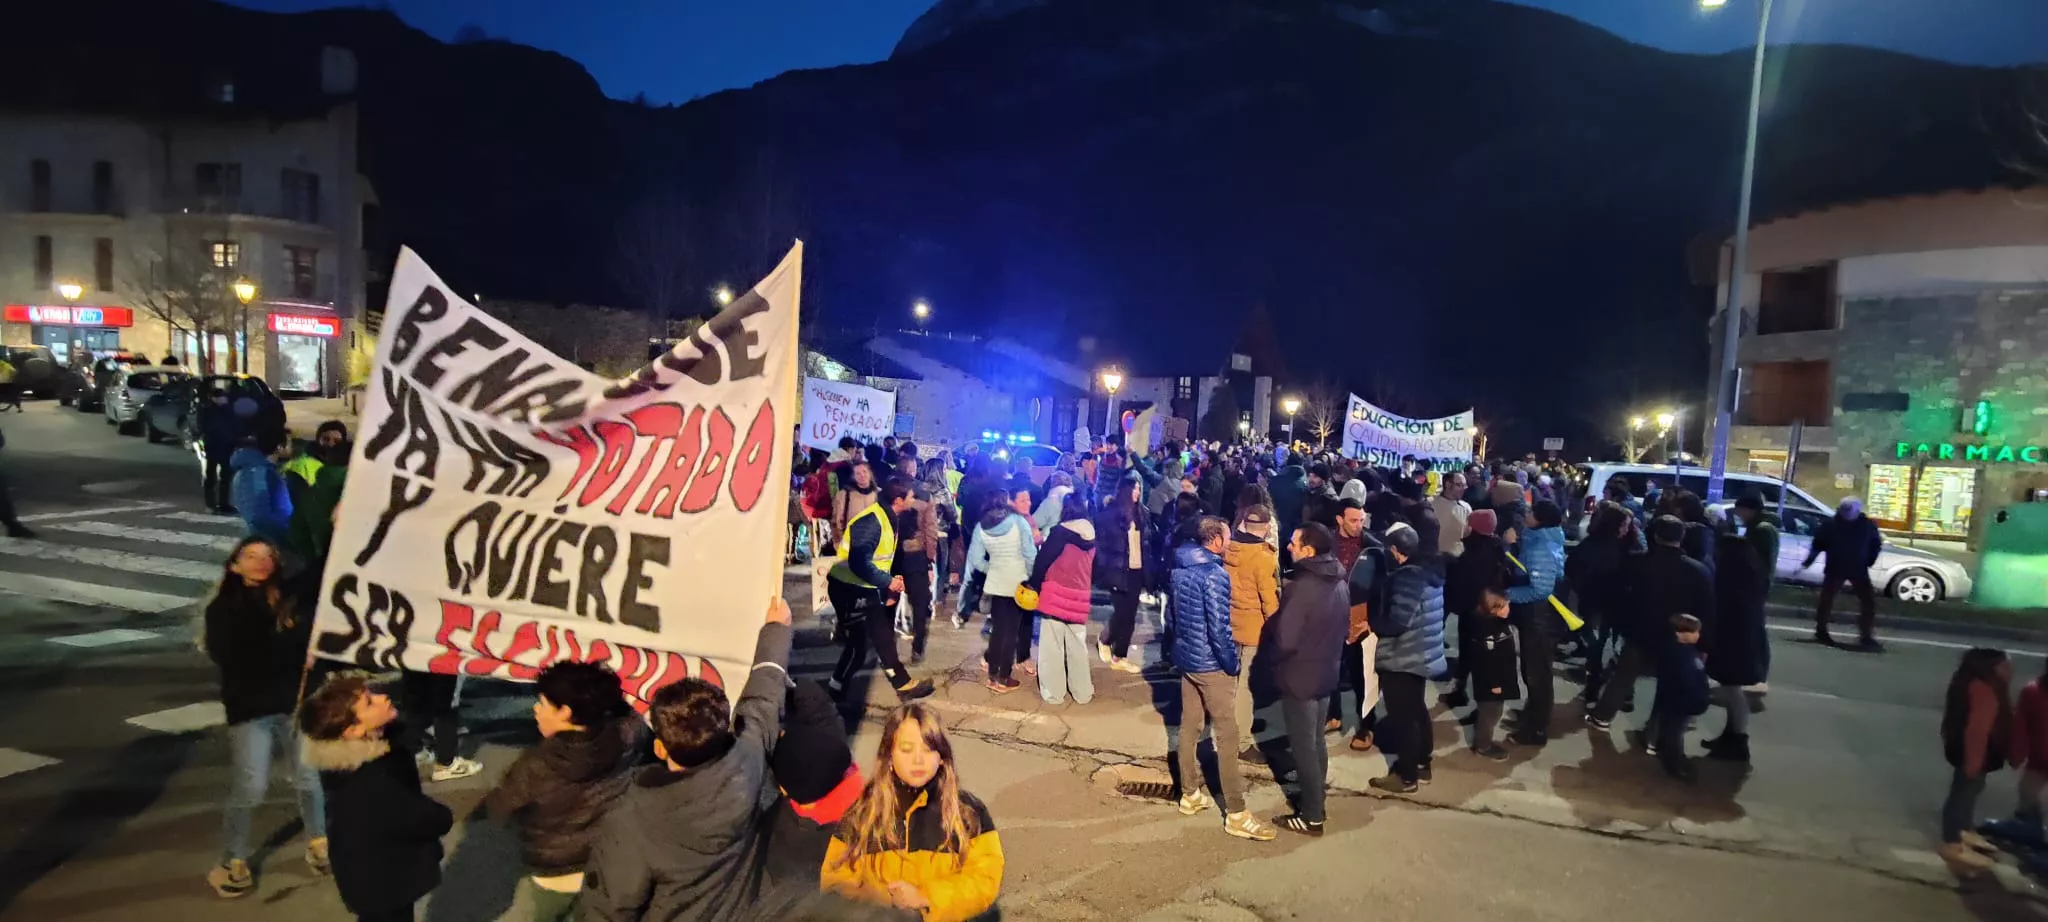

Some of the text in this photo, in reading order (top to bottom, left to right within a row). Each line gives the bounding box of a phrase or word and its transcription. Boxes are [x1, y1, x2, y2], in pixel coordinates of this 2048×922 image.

[856, 397, 870, 412] HA
[1352, 401, 1465, 435] EDUCACIÓN DE
[365, 365, 775, 519] YA HA VOTADO
[813, 421, 836, 440] LOS
[1415, 436, 1434, 453] NO
[355, 475, 671, 632] Y QUIERE
[317, 574, 414, 670] SER
